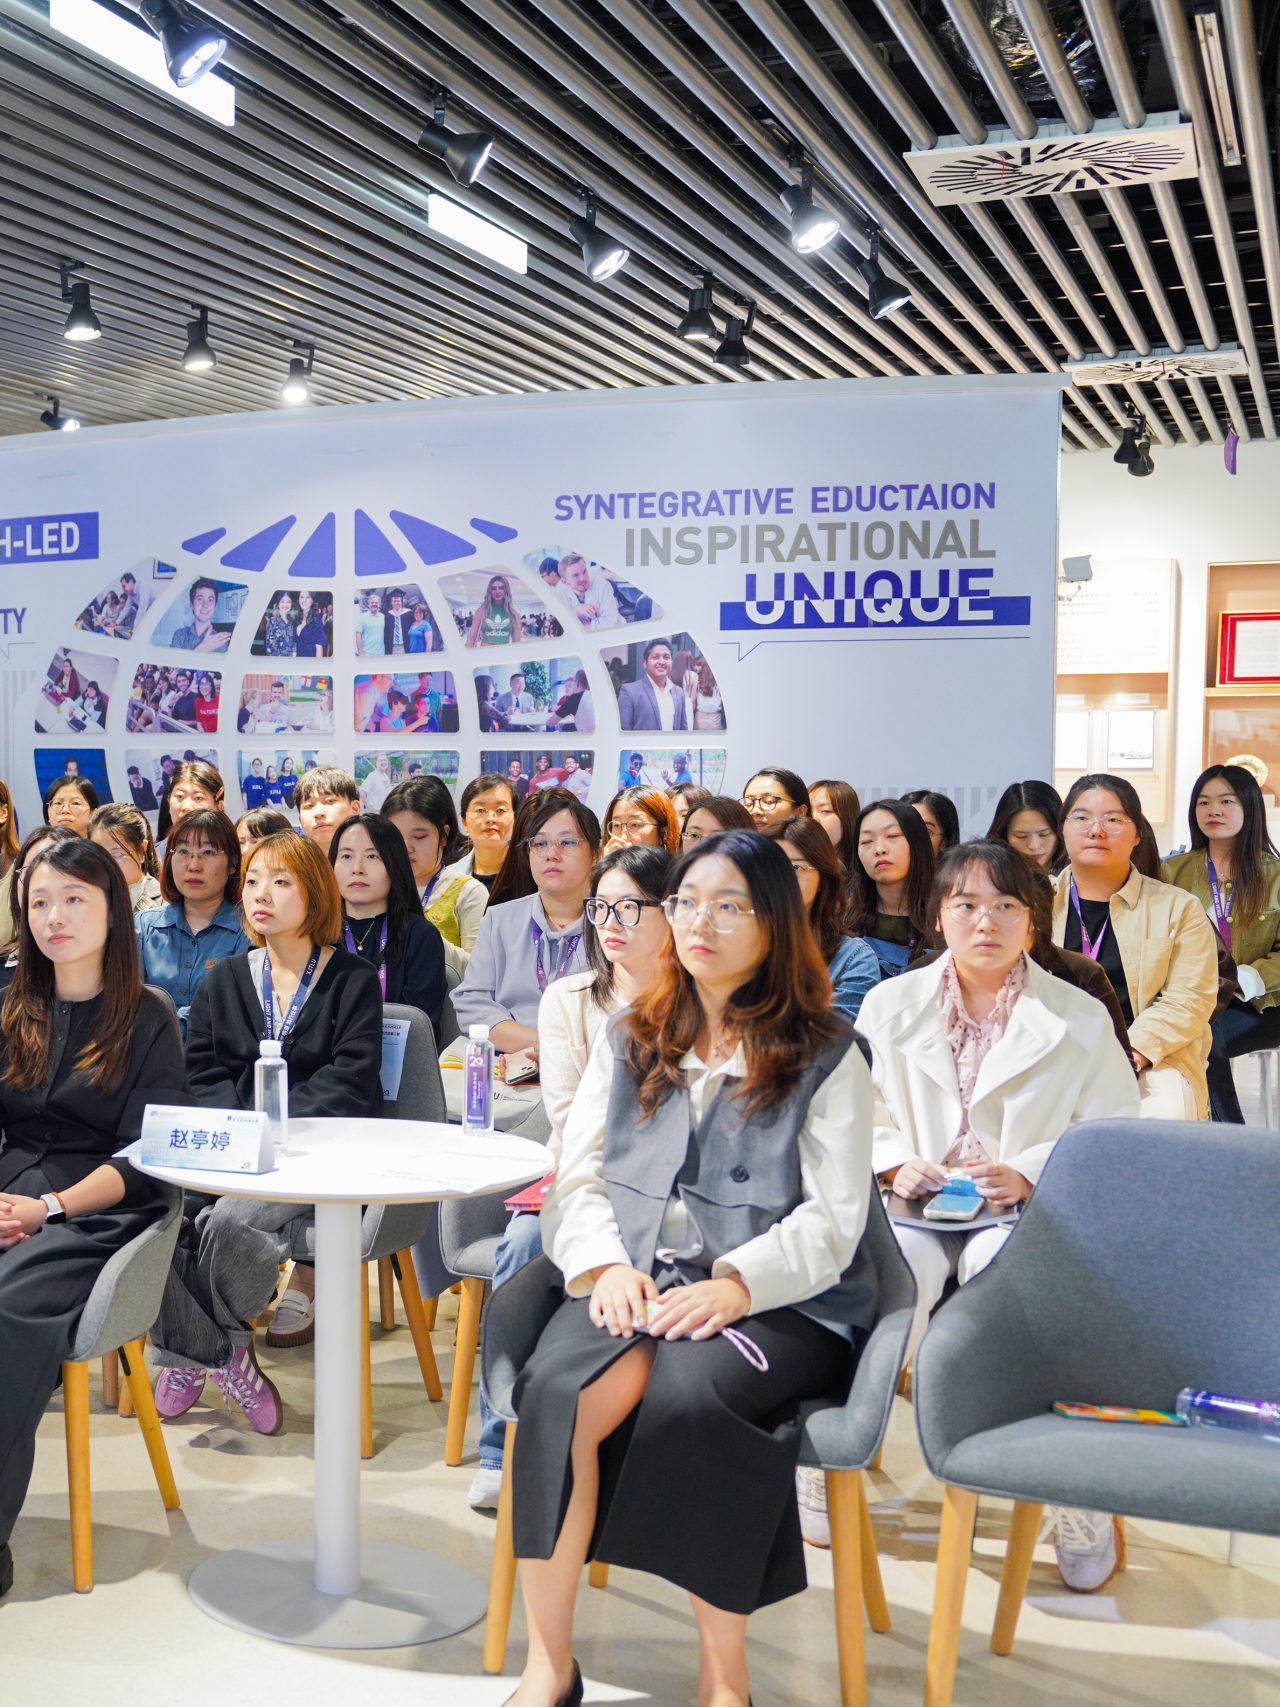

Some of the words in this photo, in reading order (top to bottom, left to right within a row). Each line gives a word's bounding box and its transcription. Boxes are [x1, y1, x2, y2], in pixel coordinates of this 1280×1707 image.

[554, 487, 794, 521] SYNTEGRATIVE
[811, 482, 996, 513] EDUCTAION
[624, 518, 996, 567] INSPIRATIONAL
[745, 567, 994, 625] UNIQUE
[264, 1000, 272, 1017] LIGHT
[469, 1056, 484, 1067] 20
[169, 1128, 231, 1151] 赵亭婷
